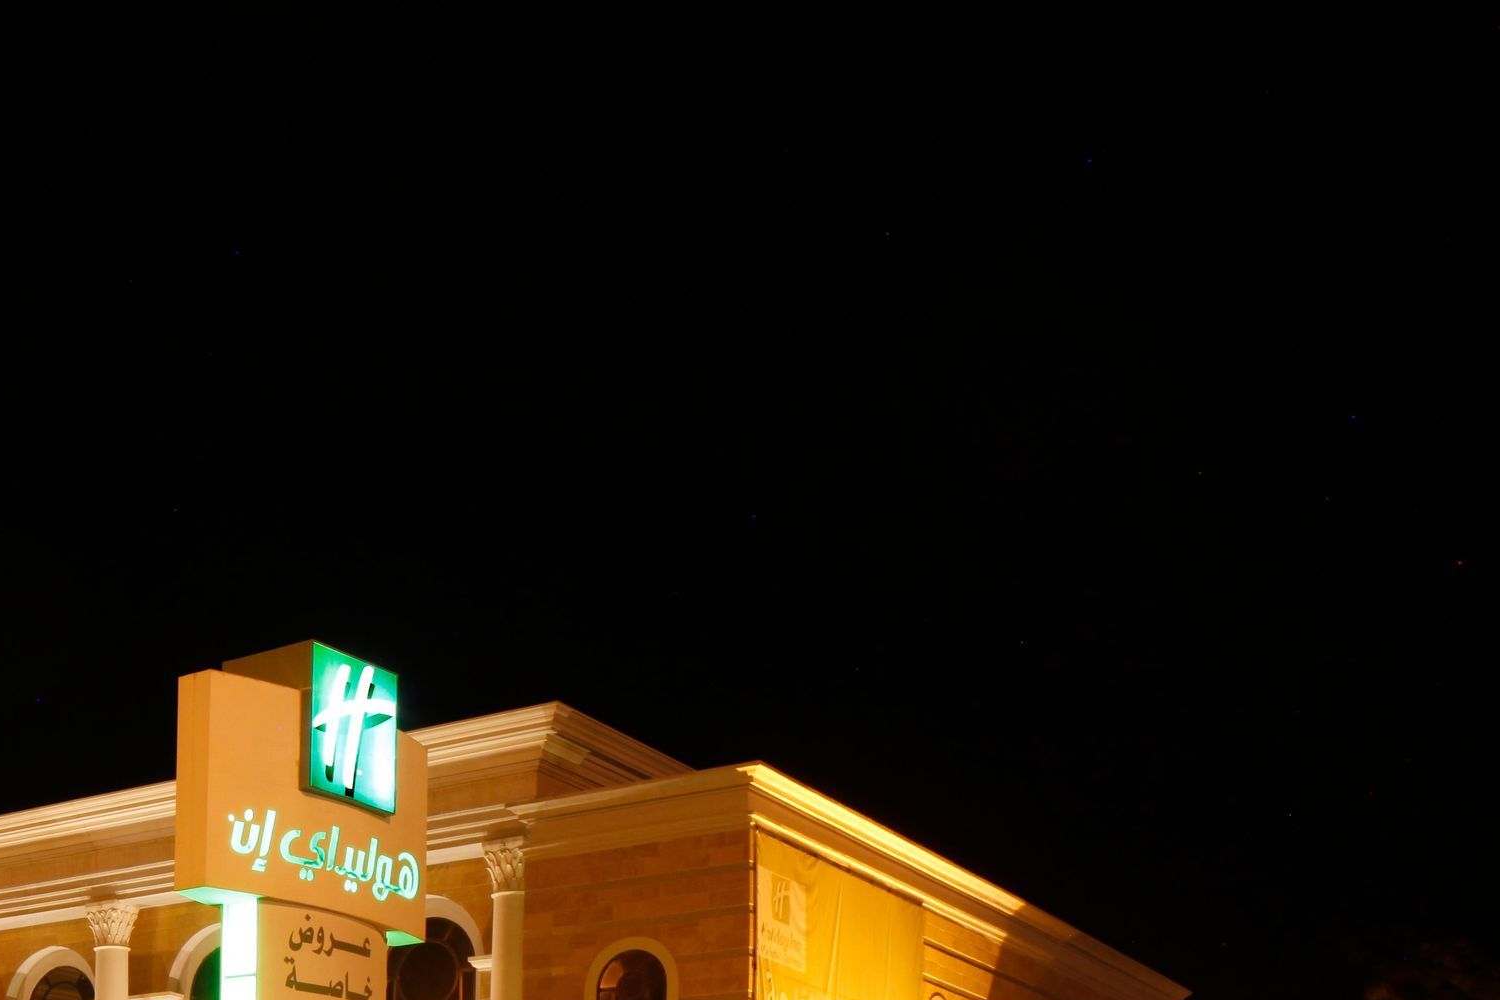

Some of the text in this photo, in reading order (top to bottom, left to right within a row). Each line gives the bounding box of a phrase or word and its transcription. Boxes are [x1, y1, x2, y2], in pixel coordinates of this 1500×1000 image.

[228, 808, 419, 901] هوليداي إن
[289, 914, 371, 958] عروض
